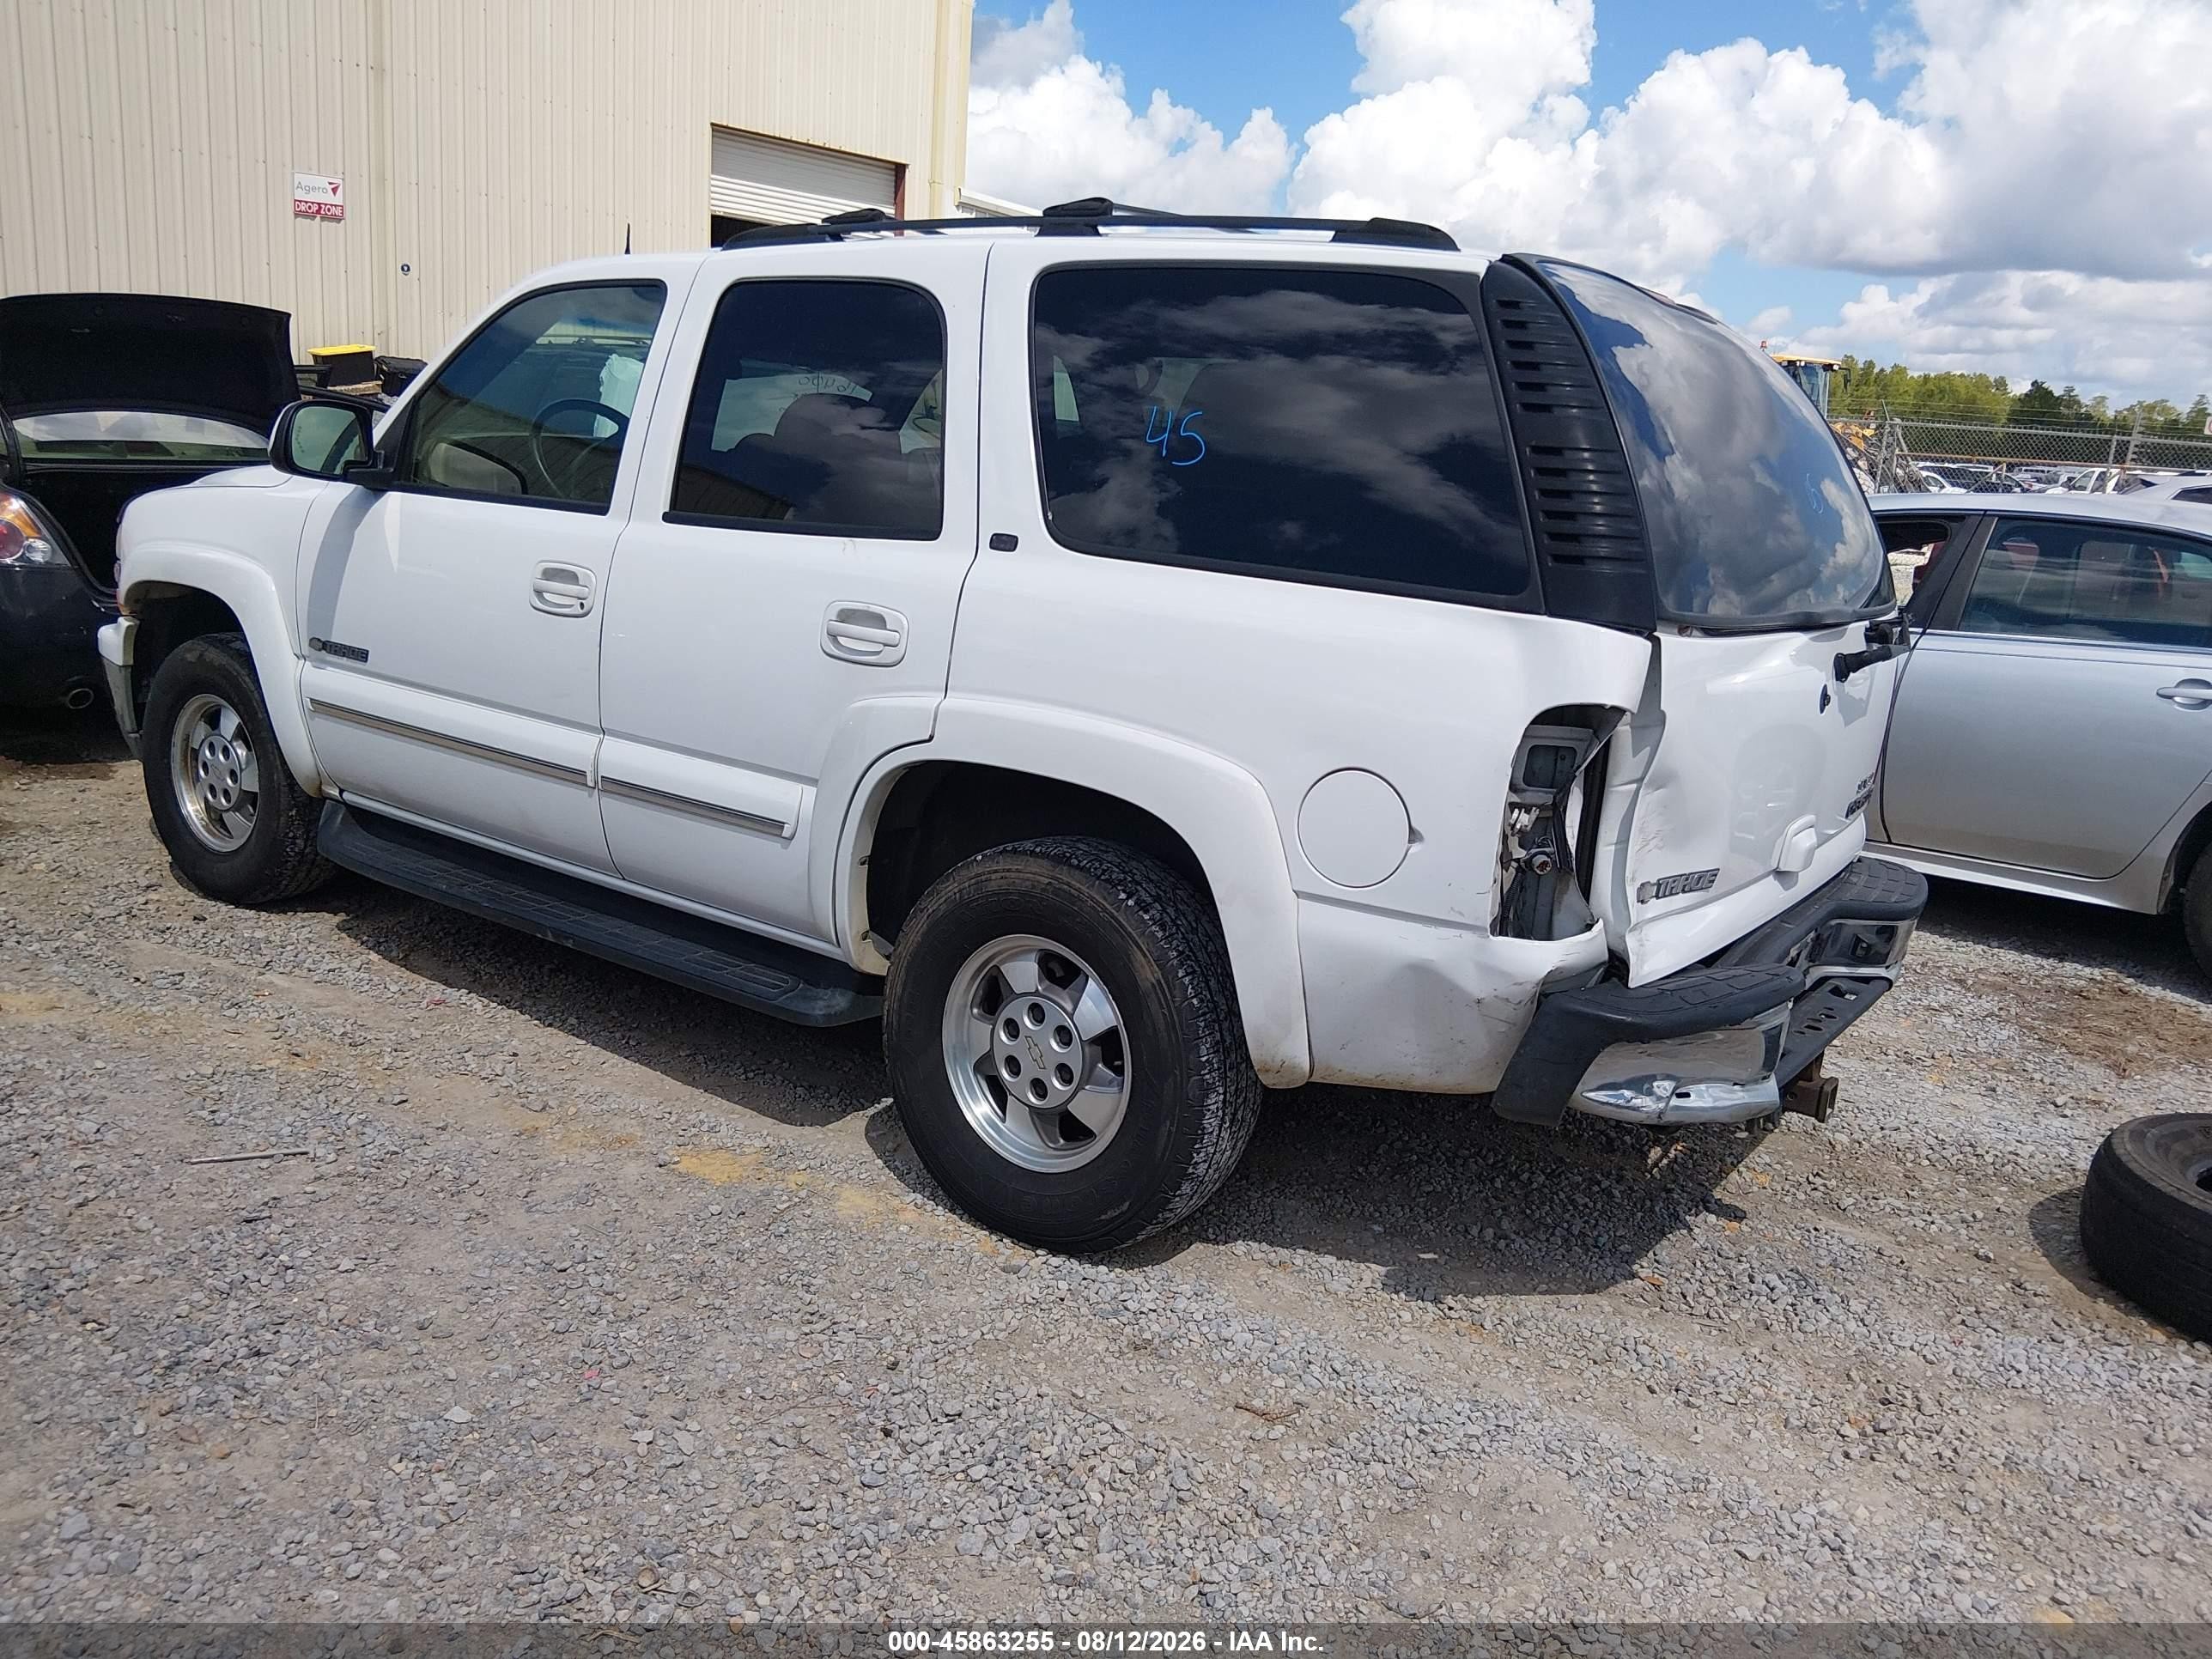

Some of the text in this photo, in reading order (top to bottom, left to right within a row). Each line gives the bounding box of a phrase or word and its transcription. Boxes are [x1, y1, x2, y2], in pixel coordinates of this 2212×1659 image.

[295, 180, 328, 194] Agero
[295, 201, 343, 216] DROP ZONE
[1146, 405, 1206, 465] 45
[1657, 870, 1719, 898] TAHOE
